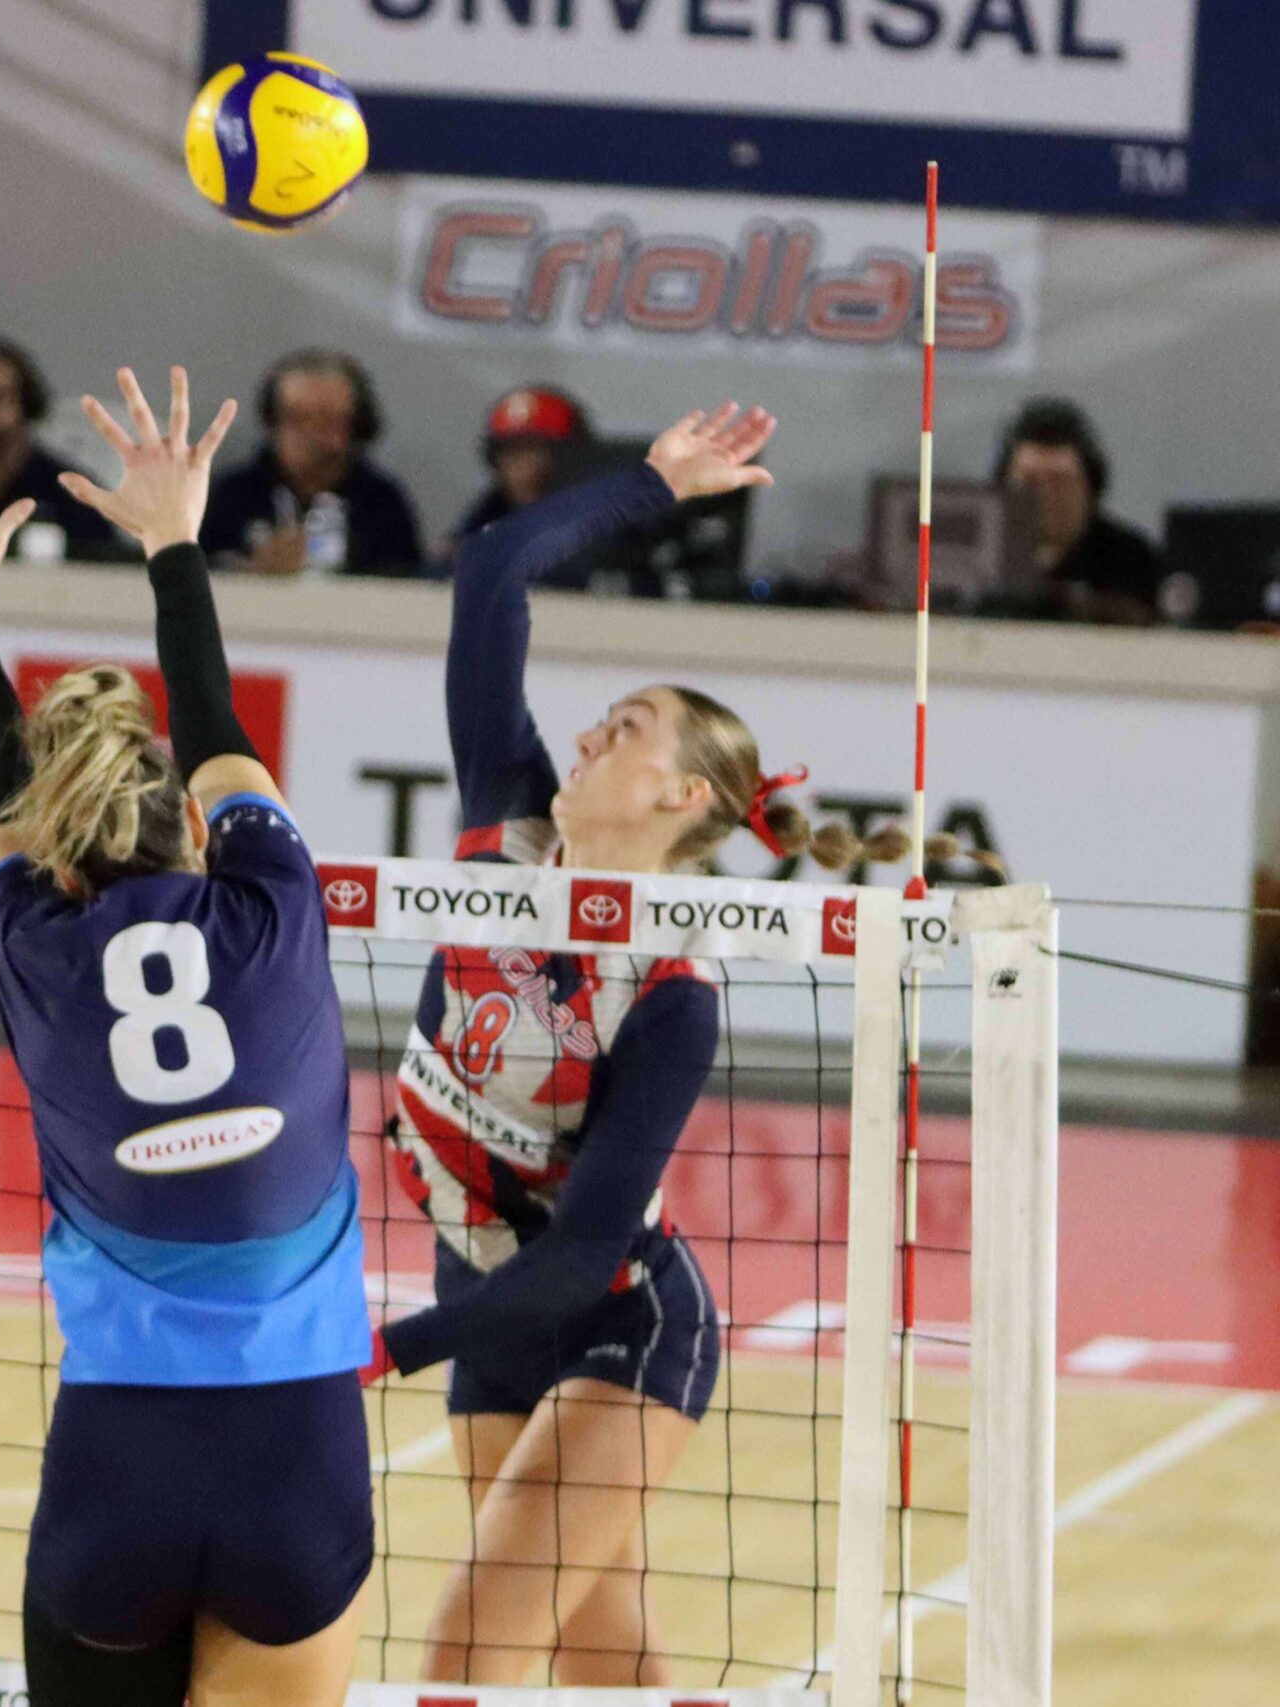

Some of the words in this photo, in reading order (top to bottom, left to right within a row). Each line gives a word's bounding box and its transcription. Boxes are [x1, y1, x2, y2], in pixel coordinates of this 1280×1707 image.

[422, 207, 1014, 353] Criollas
[392, 885, 538, 919] TOYOTA
[648, 902, 789, 935] TOYOTA
[103, 921, 236, 1105] 8
[453, 990, 517, 1084] 8
[129, 1115, 275, 1160] TROPIGAS
